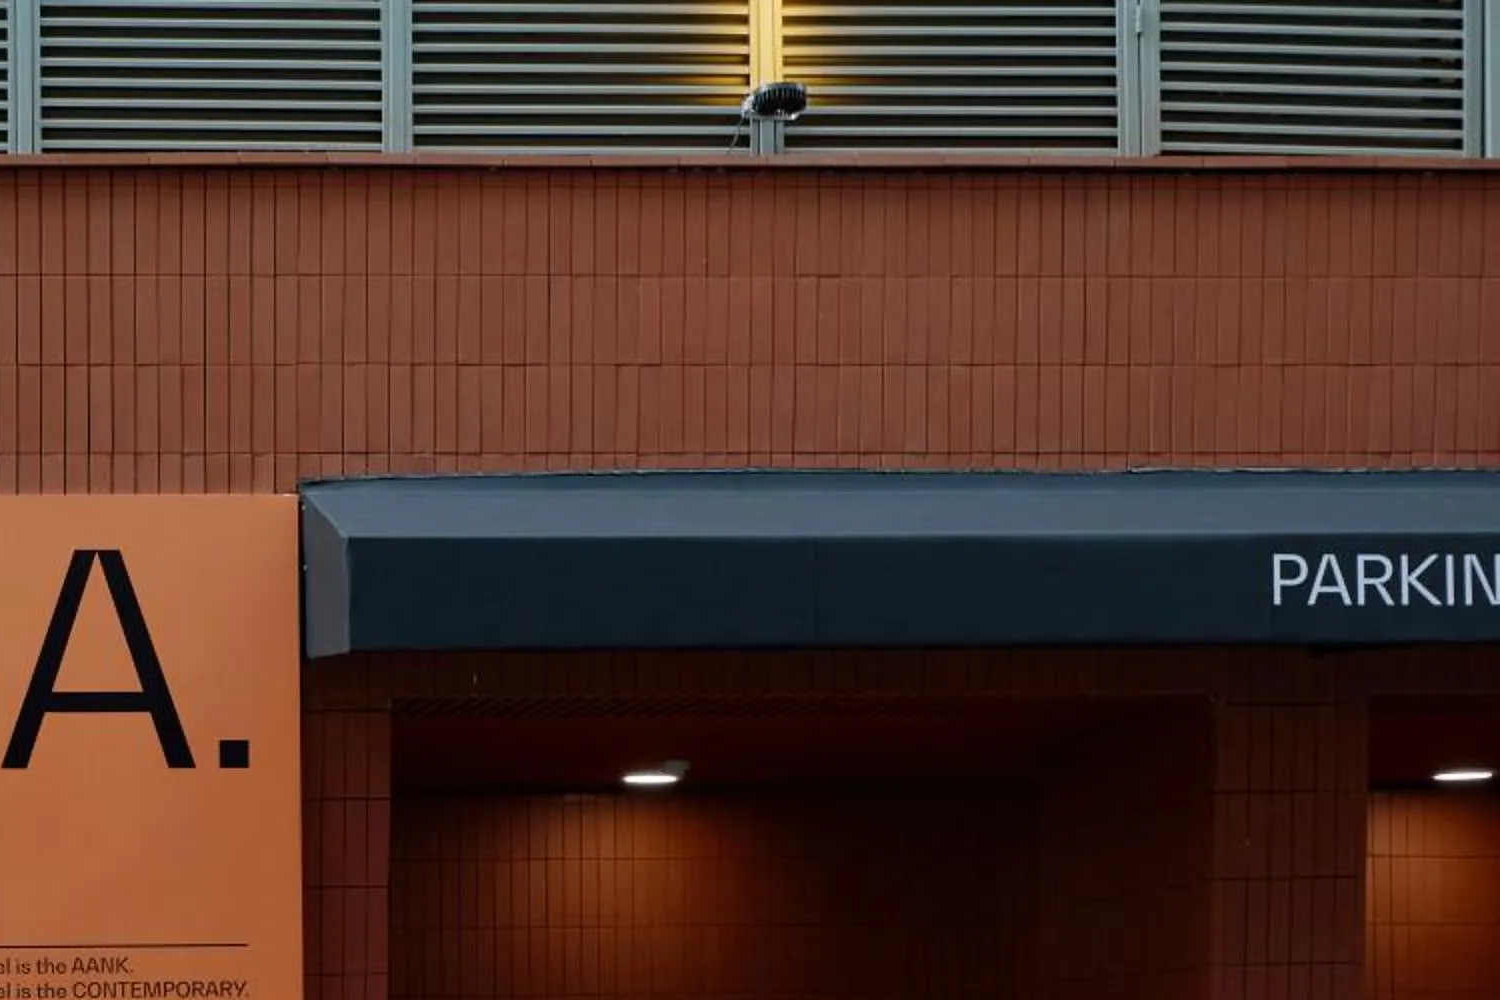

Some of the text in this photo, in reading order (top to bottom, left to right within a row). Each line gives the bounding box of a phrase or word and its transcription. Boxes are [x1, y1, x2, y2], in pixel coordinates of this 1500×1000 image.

[1272, 553, 1500, 606] PARKIN
[0, 549, 250, 770] A.
[15, 957, 32, 975] is
[36, 956, 67, 975] the
[71, 956, 135, 975] AANK.
[16, 982, 32, 999] is
[36, 982, 68, 999] the
[72, 980, 250, 999] CONTEMPORARY.
